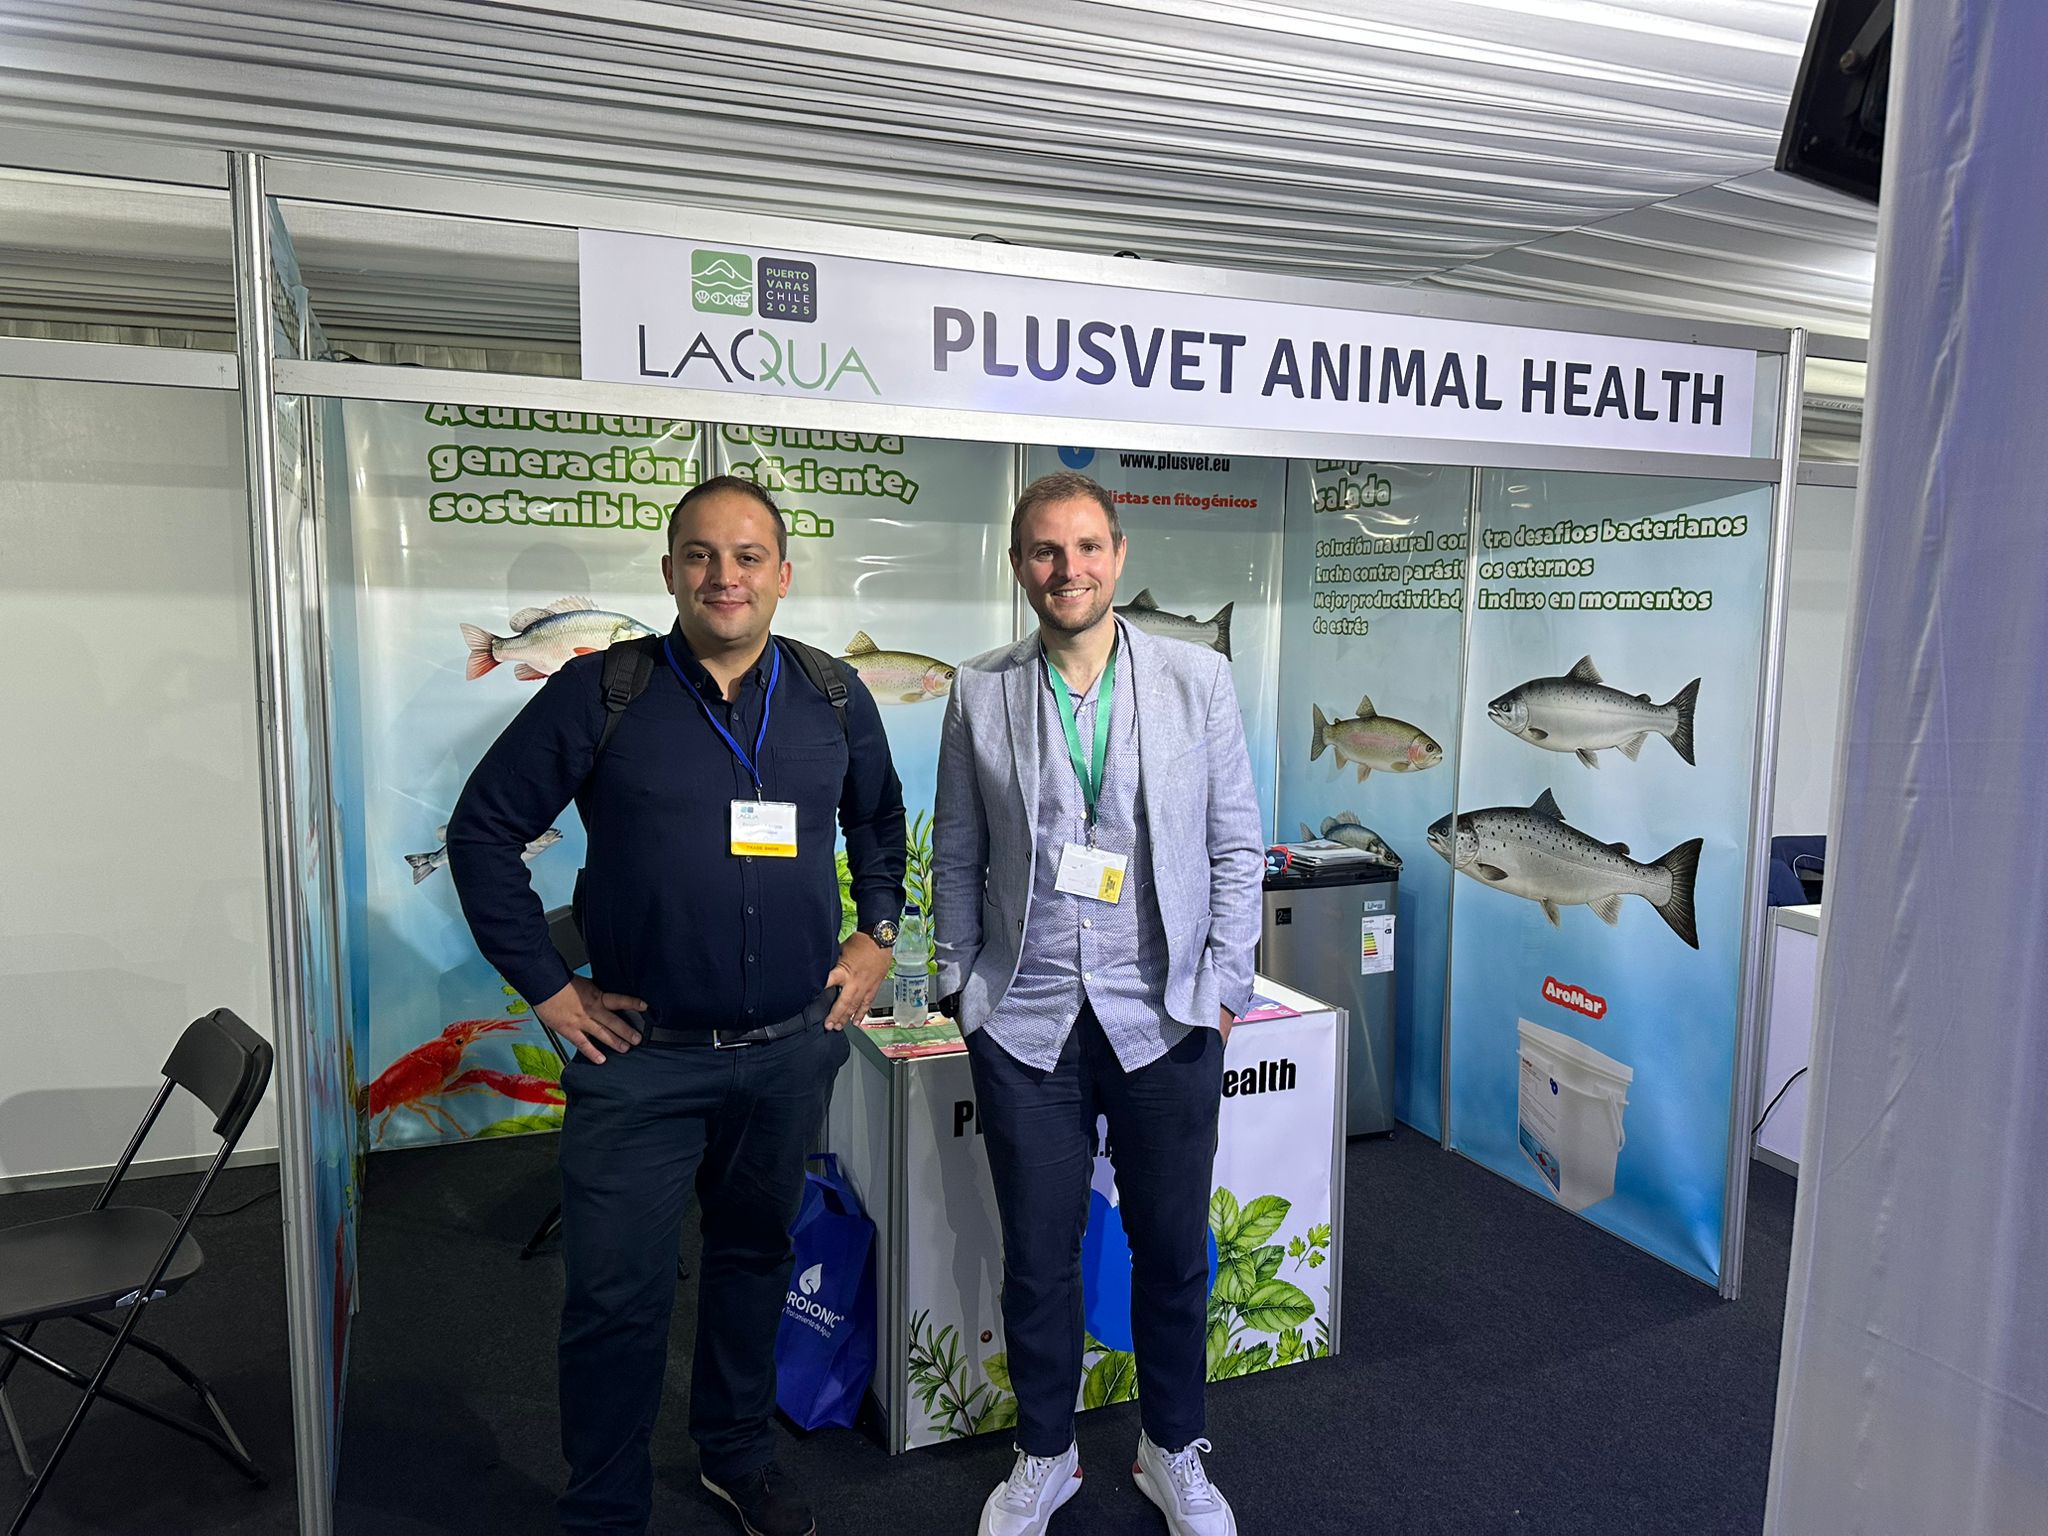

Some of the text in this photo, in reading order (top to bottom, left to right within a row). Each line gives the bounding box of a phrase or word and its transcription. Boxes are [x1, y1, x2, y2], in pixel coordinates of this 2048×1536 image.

[766, 267, 809, 281] PUERTO
[766, 279, 809, 292] VARAS
[765, 290, 810, 304] CHILE
[766, 302, 810, 315] 2025
[638, 324, 881, 397] LAQUA
[933, 305, 1724, 426] PLUSVET ANIMAL HEALTH
[781, 428, 904, 454] nueva
[428, 444, 919, 504] generación: eficiente,
[1119, 453, 1231, 472] www.plusvet.eu
[1152, 494, 1171, 506] en
[1174, 492, 1258, 510] fitogénicos
[1314, 473, 1392, 513] salada
[429, 489, 662, 531] sostenible
[1315, 535, 1371, 558] Solución
[1374, 531, 1434, 555] natural
[1514, 520, 1598, 547] desafíos
[1601, 514, 1748, 542] bacterianos
[1315, 564, 1350, 583] Lucha
[1353, 564, 1400, 583] contra
[1506, 557, 1594, 578] externos
[1313, 591, 1349, 613] Mejor
[1478, 588, 1546, 610] incluso
[1549, 591, 1575, 609] en
[1579, 587, 1712, 610] momentos
[1313, 616, 1369, 635] de estrés
[1545, 981, 1603, 1014] AroMar
[1222, 1058, 1297, 1098] ealth
